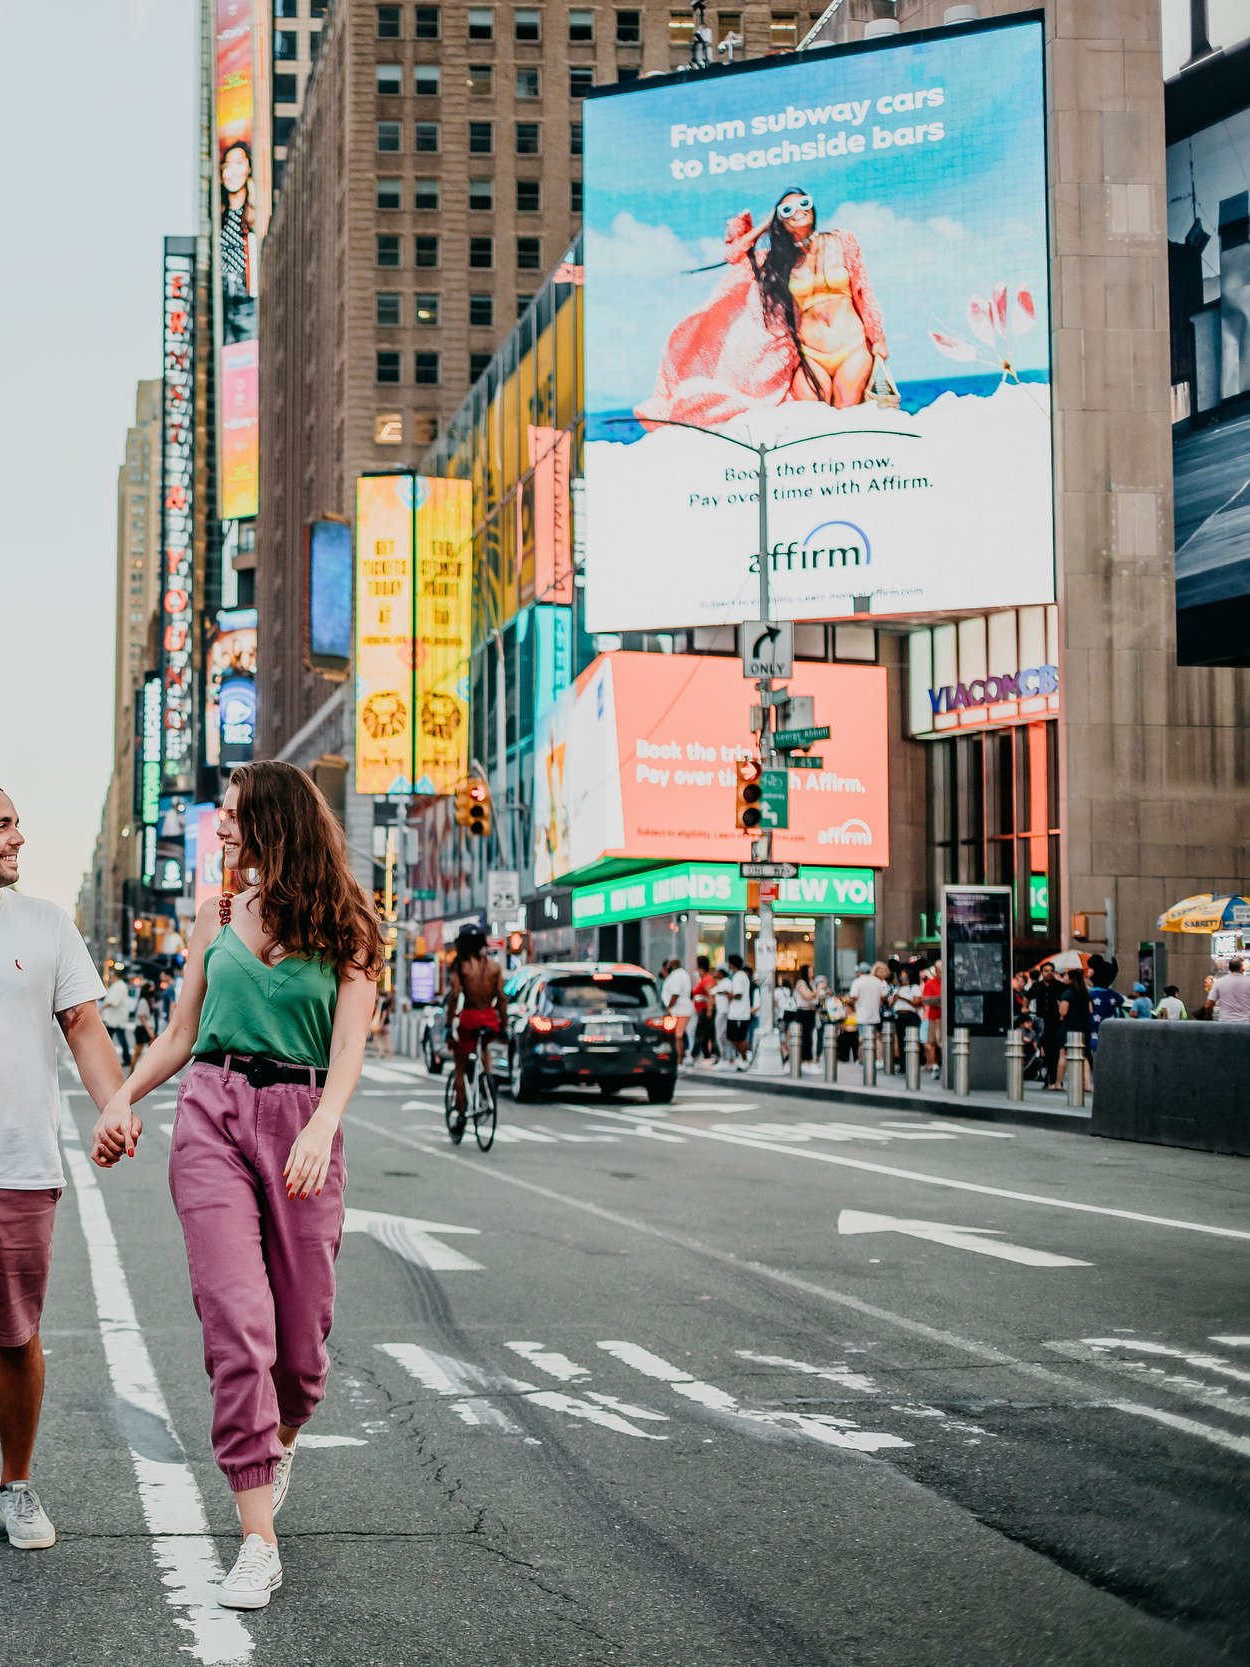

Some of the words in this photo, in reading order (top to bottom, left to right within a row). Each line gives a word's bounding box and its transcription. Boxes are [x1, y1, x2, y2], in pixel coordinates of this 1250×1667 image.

[670, 119, 745, 148] From
[750, 98, 872, 136] subway
[876, 87, 945, 115] cars
[670, 158, 703, 180] to
[708, 131, 866, 175] beachside
[872, 121, 945, 151] bars
[725, 467, 767, 481] Boo
[776, 463, 805, 477] the
[812, 458, 845, 475] trip
[852, 456, 894, 470] now.
[689, 494, 720, 508] Pay
[727, 491, 760, 504] ove
[773, 487, 813, 500] time
[820, 480, 860, 496] with
[867, 475, 933, 492] Affirm.
[751, 663, 786, 675] ONLY
[636, 739, 682, 760] Book
[686, 741, 716, 762] the
[636, 764, 670, 788] Pay
[673, 769, 715, 787] over
[806, 772, 866, 793] Affirm.
[818, 826, 871, 846] affirm
[748, 866, 765, 875] ONE
[709, 1120, 1018, 1142] ONLY
